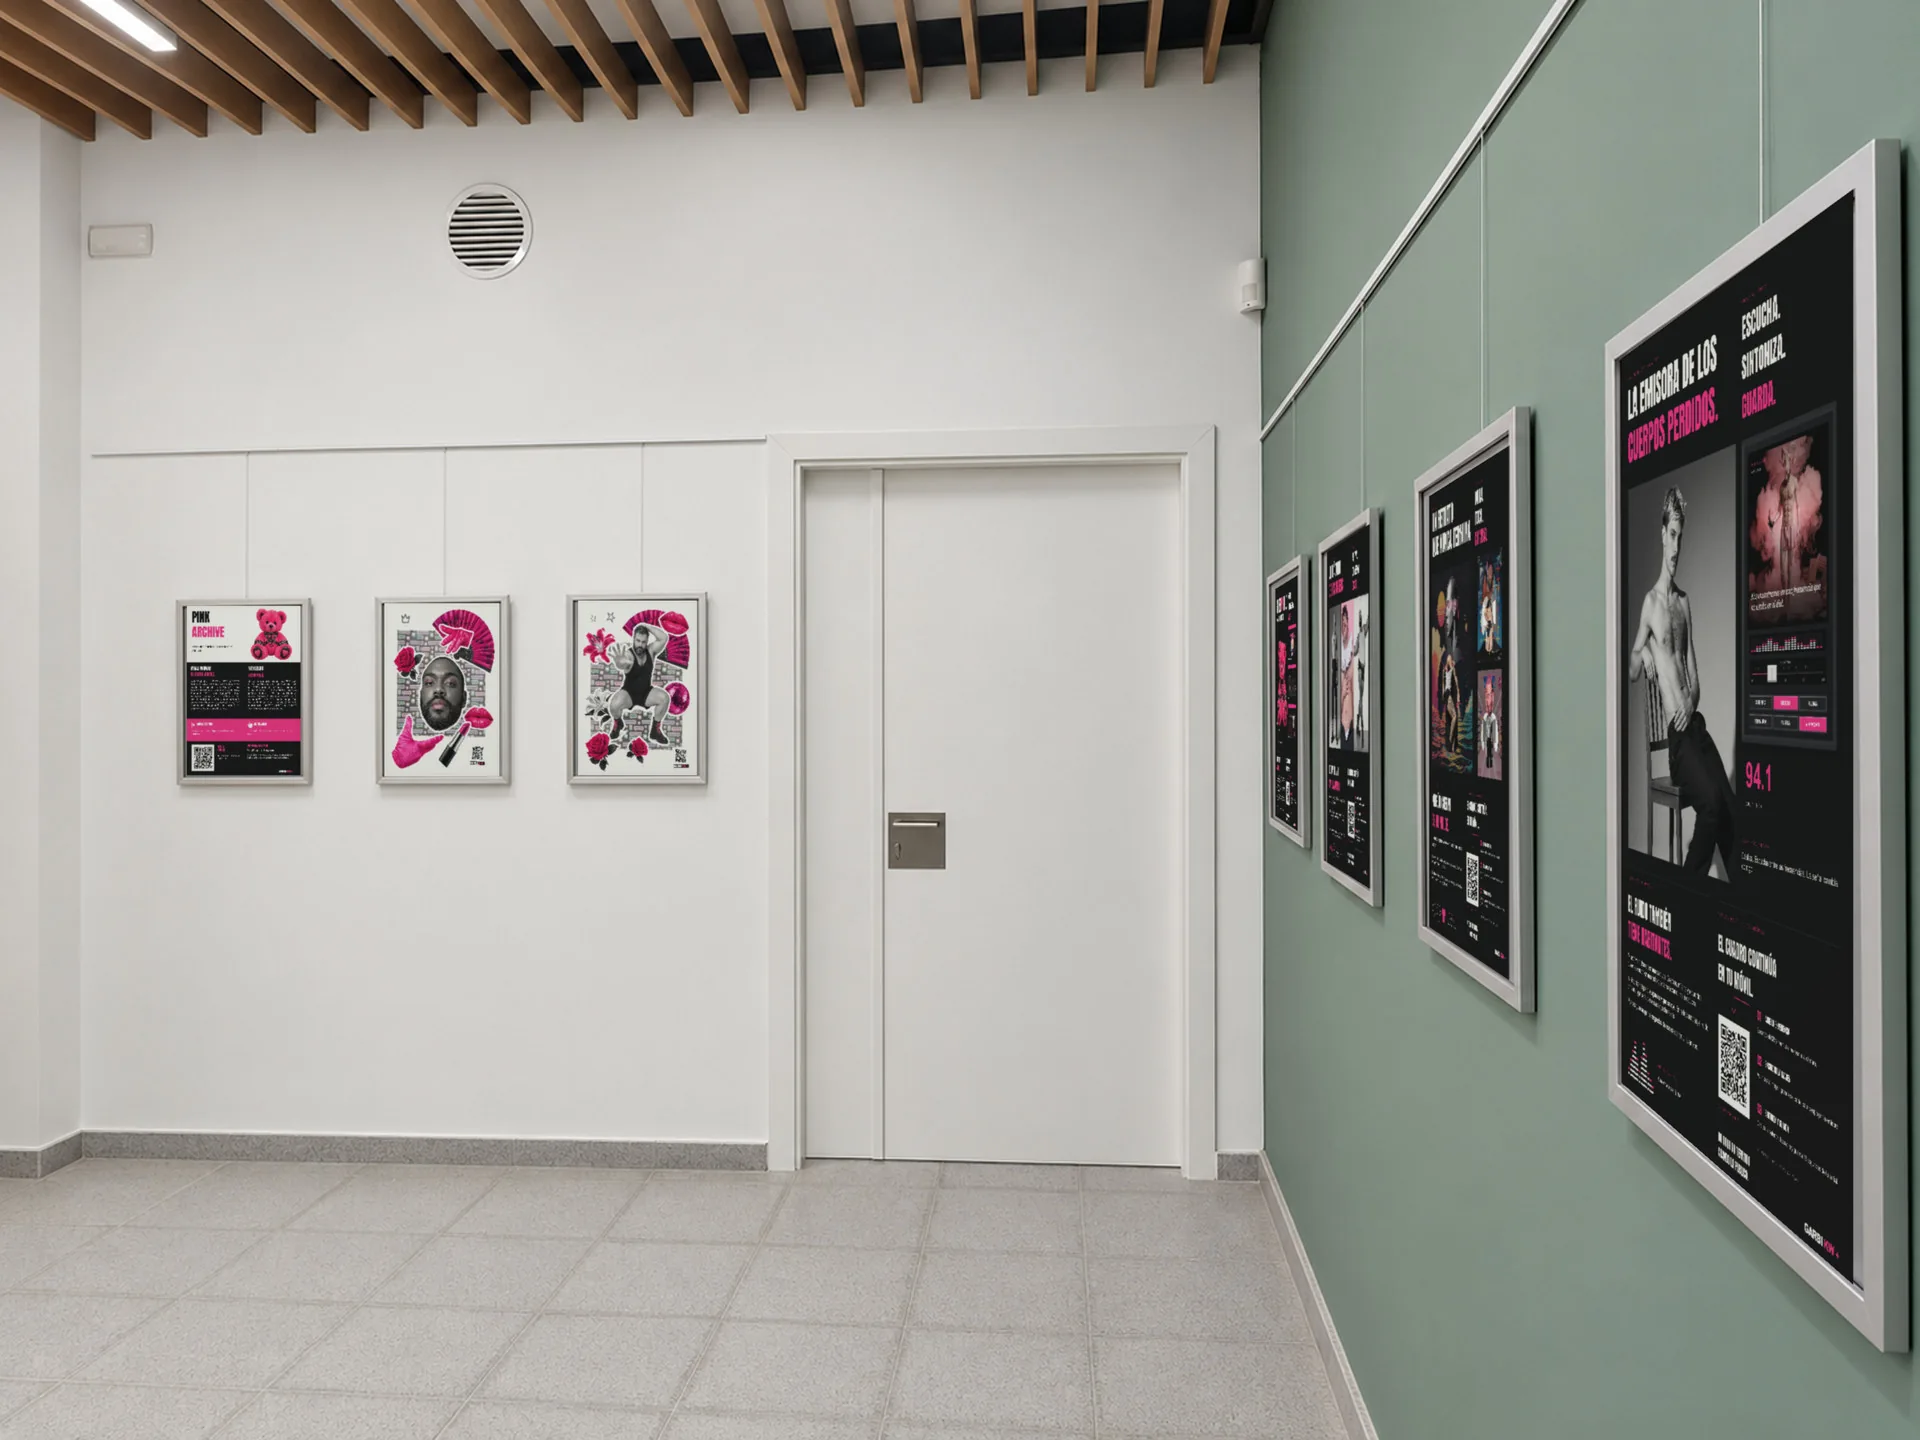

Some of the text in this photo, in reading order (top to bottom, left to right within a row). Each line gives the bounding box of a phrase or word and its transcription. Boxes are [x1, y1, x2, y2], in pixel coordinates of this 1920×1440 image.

[1741, 294, 1781, 340] ESCUCHA.
[1628, 386, 1638, 420] LA
[1640, 358, 1679, 414] EMISORA
[1682, 348, 1695, 389] DE
[1697, 334, 1717, 380] LOS
[1741, 333, 1786, 380] SINTONIZA.
[1741, 380, 1776, 418] GUARDA.
[1628, 386, 1718, 463] CUERPOS PERDIDOS.
[192, 611, 210, 623] PINK
[192, 626, 225, 638] ARCHIVE
[1745, 761, 1772, 792] 94.1
